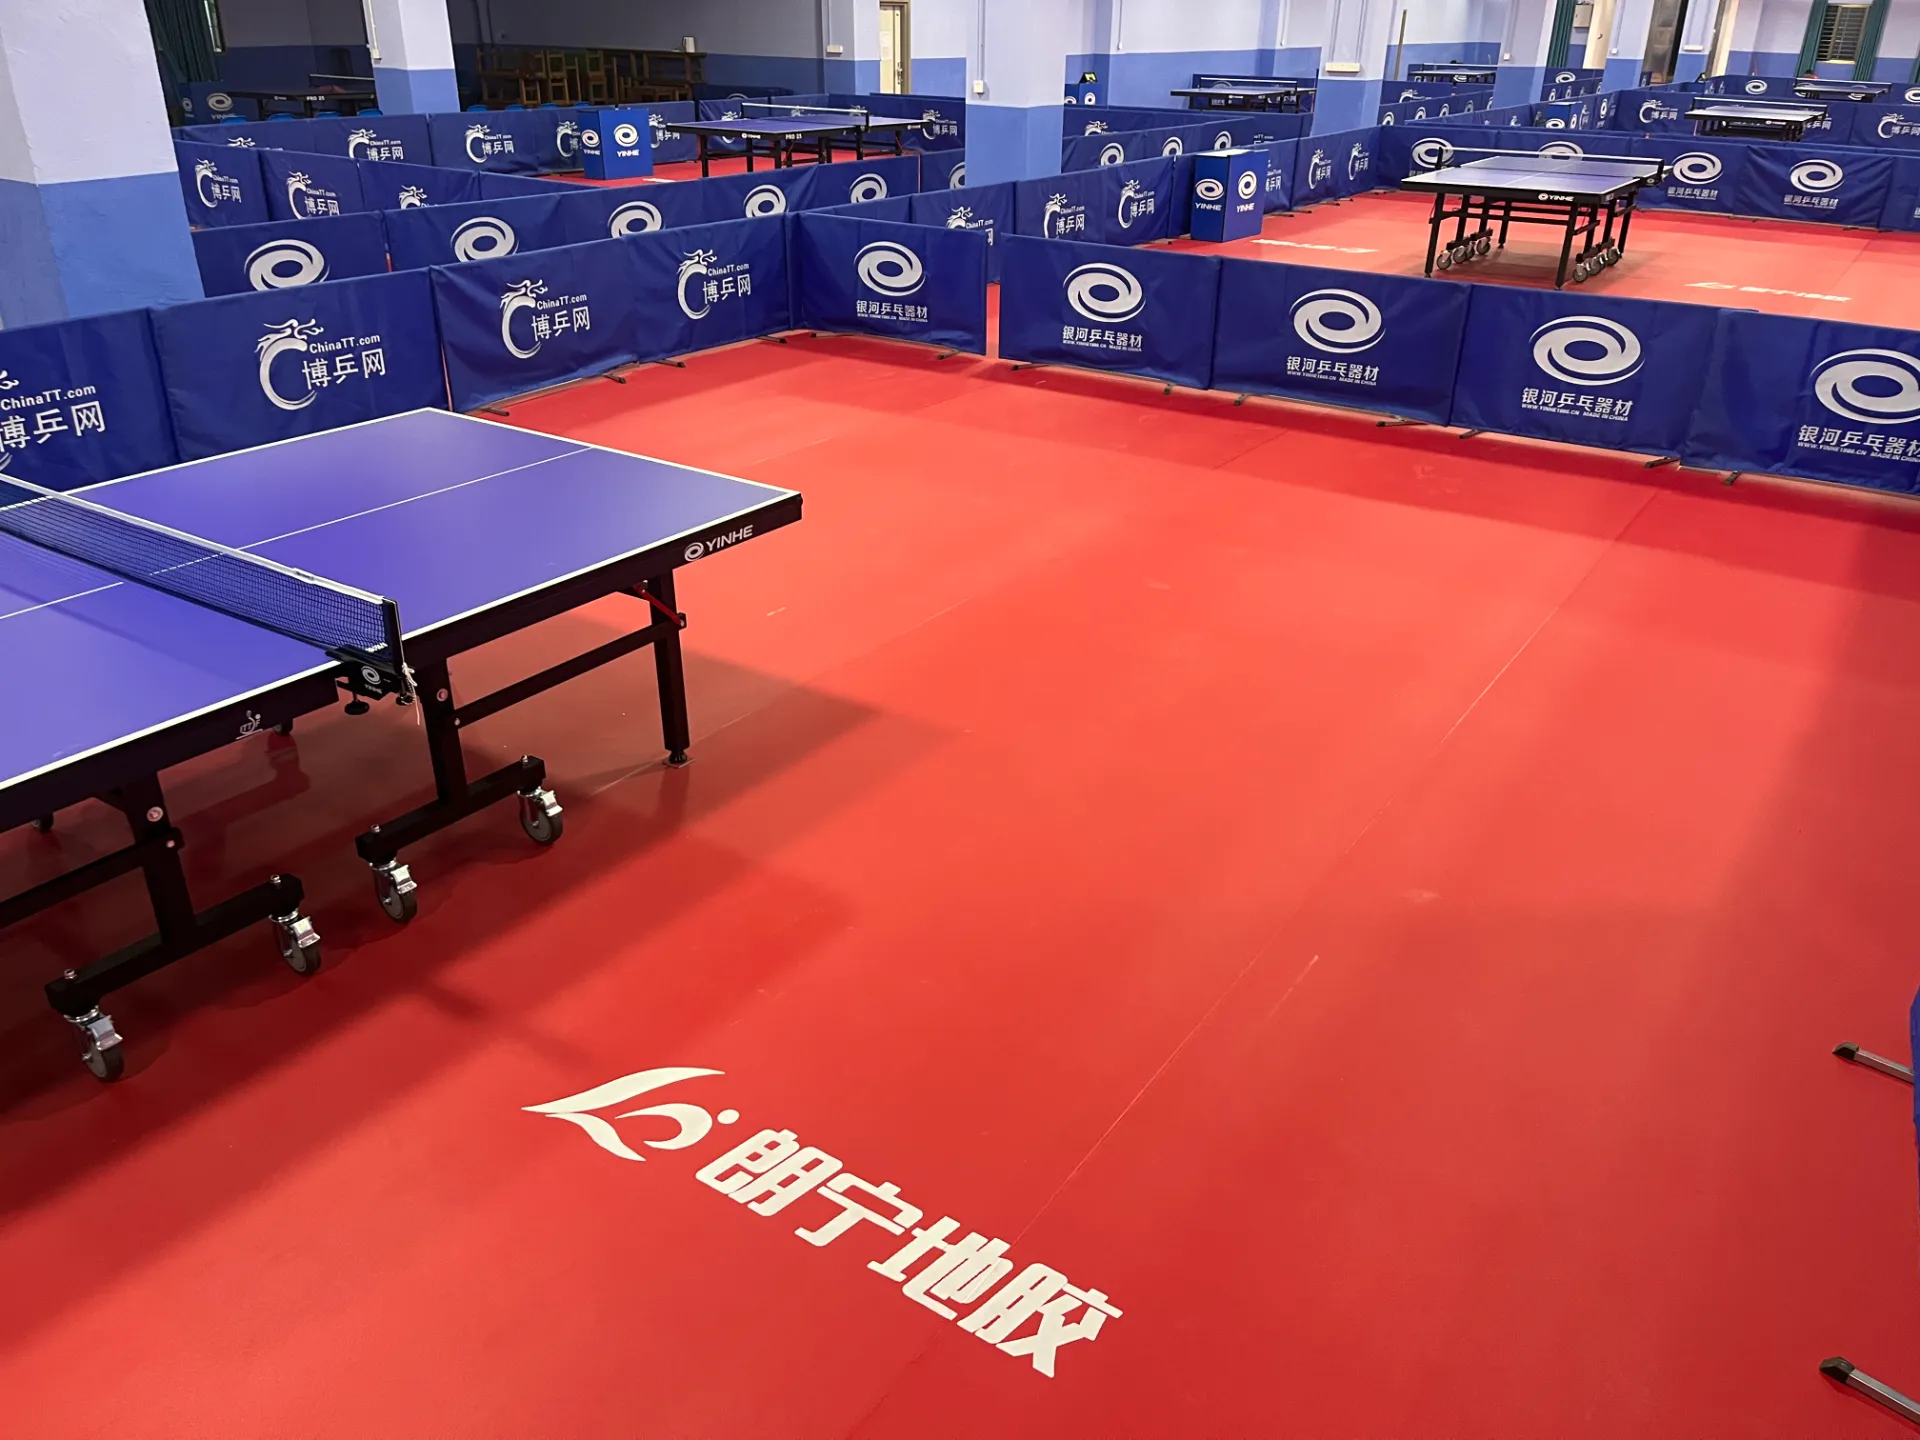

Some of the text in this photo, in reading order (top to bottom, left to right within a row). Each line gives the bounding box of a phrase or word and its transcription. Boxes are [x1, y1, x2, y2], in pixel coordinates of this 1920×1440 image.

[367, 146, 404, 161] 博乒网
[481, 140, 515, 155] 博乒网
[617, 149, 639, 157] YINHE
[210, 182, 242, 203] 博乒网
[1549, 194, 1574, 202] YINHE
[304, 195, 340, 216] 博乒网
[1130, 198, 1155, 218] 博乒网
[1194, 202, 1222, 211] YINHE
[1236, 202, 1255, 212] YINHE
[1055, 213, 1085, 235] 博乒网
[708, 263, 750, 276] ChinaTT.com
[702, 273, 751, 304] 博乒网
[537, 294, 587, 310] ChinaTT.com
[856, 299, 928, 319] 银河乒乓器材
[531, 306, 590, 341] 博乒网
[309, 335, 381, 353] ChinaTT.com
[1062, 325, 1143, 348] 银河乒乓器材
[301, 348, 386, 390] 博乒网
[1286, 355, 1379, 382] 银河乒乓器材
[1338, 376, 1354, 384] MADE
[0, 385, 97, 411] ChinaTT.com
[1521, 387, 1634, 416] 银河乒乓器材
[0, 401, 106, 452] 博乒网
[1869, 451, 1892, 459] MADE
[706, 524, 754, 552] YINHE
[696, 1129, 1123, 1378] 朗宁地胶
